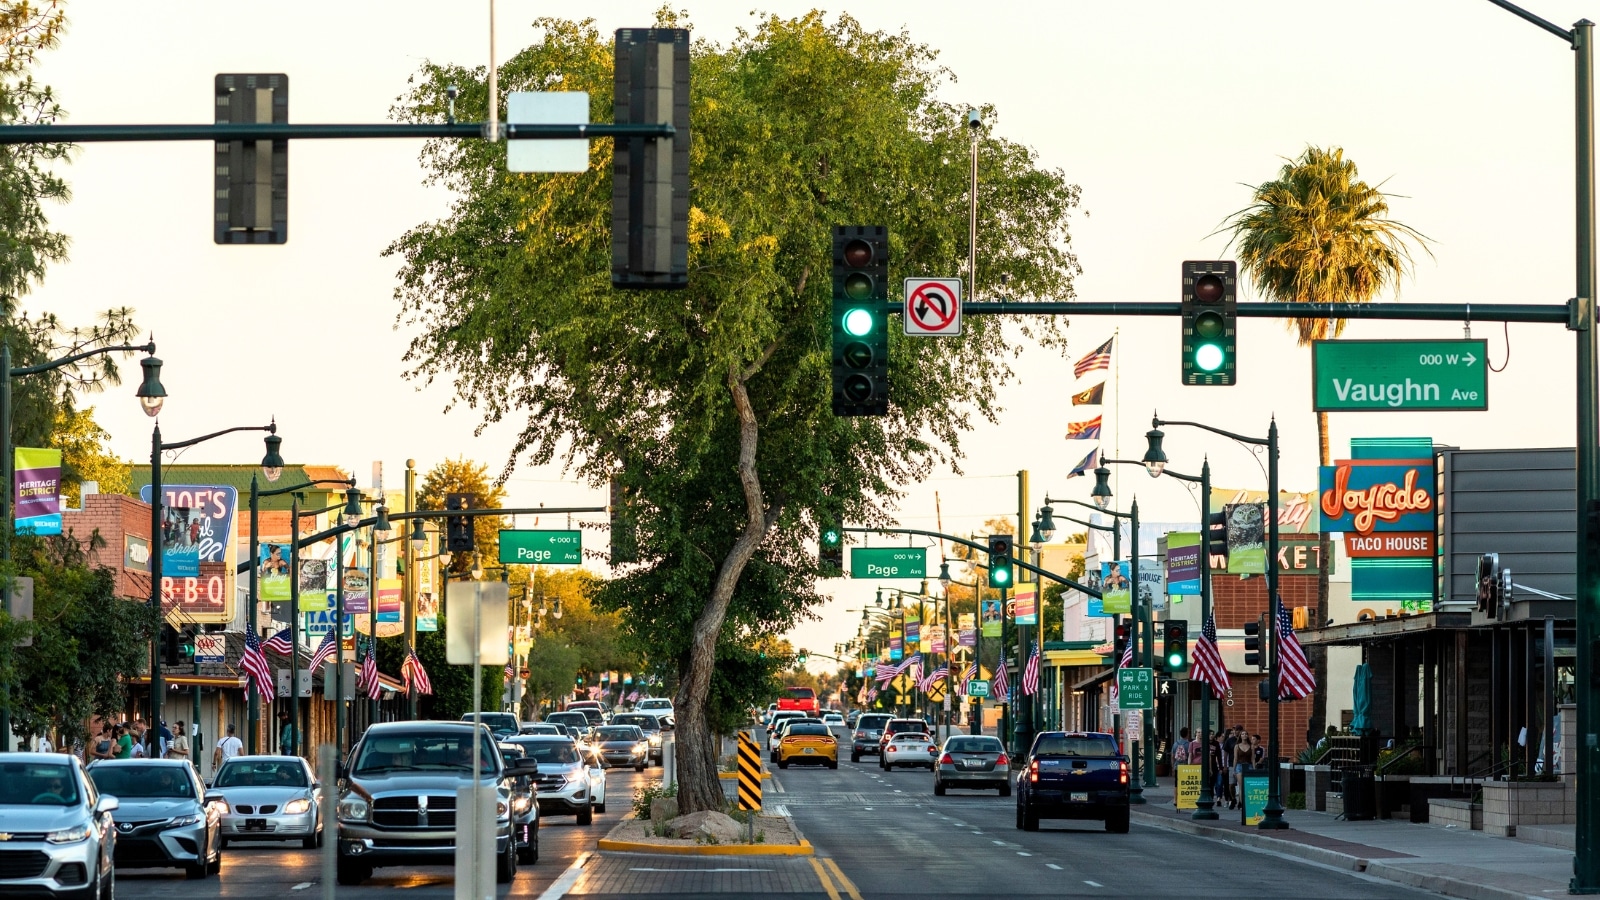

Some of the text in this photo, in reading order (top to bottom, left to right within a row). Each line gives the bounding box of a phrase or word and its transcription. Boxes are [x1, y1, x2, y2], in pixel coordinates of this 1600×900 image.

[1419, 354, 1459, 366] 000 W
[1333, 378, 1478, 407] Vaughn Ave
[19, 479, 57, 490] HERITAGE
[19, 486, 57, 498] DISTRICT
[1322, 465, 1431, 532] Joyride
[166, 490, 227, 519] JOE'S
[165, 542, 198, 557] Shop
[1350, 536, 1428, 551] TACO HOUSE
[517, 547, 578, 562] Page Ave
[1170, 553, 1198, 562] HERITAGE
[1170, 559, 1197, 568] DISTRICT
[867, 564, 899, 577] Page
[345, 592, 366, 602] Dine
